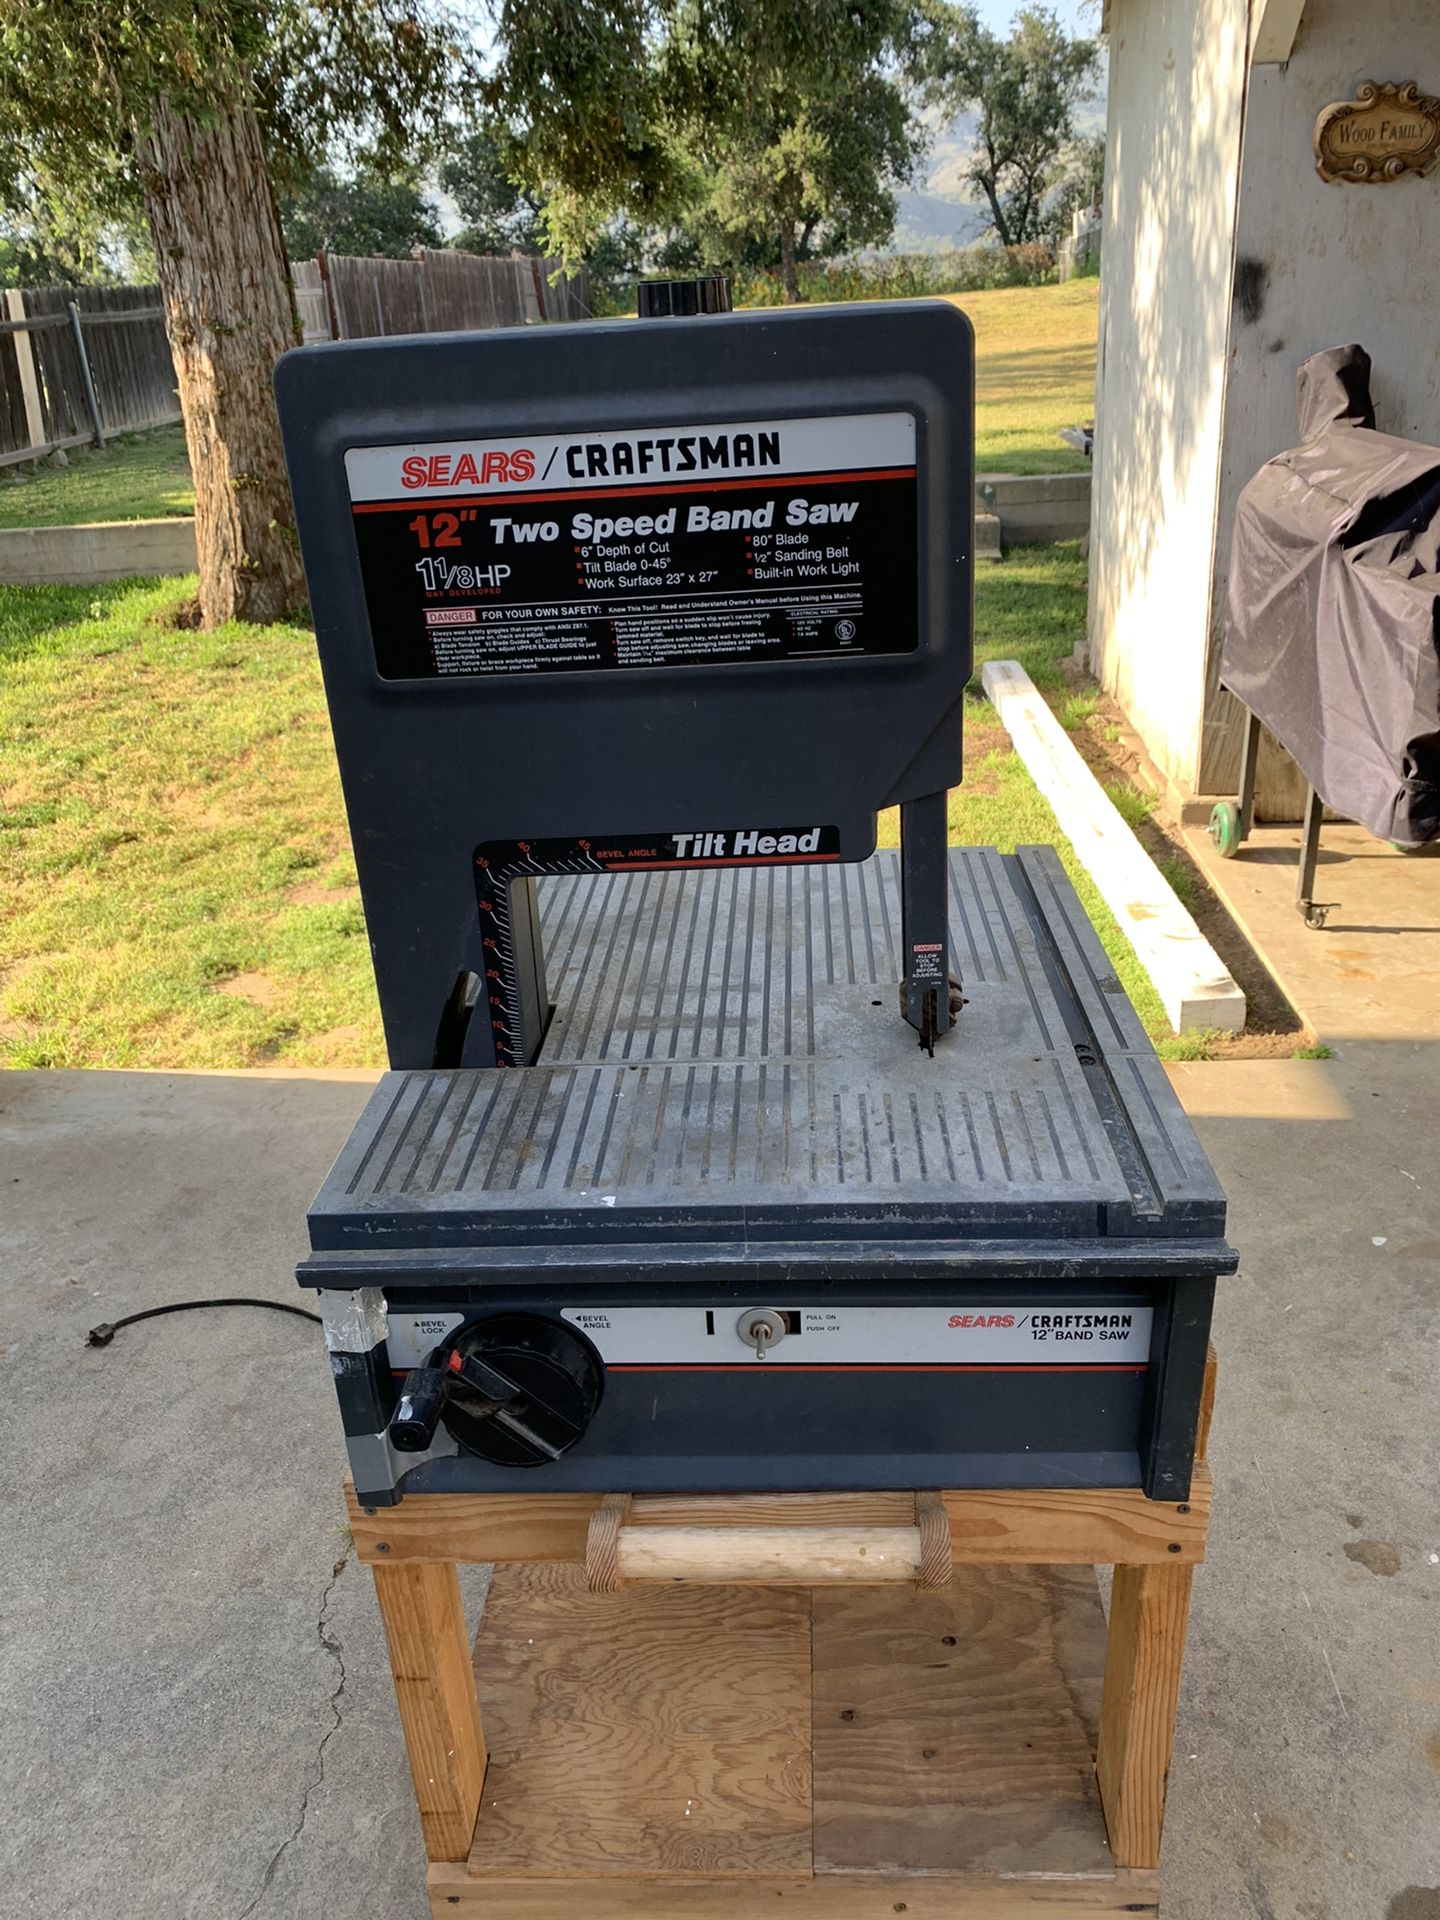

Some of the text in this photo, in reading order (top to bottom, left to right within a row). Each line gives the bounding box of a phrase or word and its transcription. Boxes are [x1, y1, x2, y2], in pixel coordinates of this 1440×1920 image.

[400, 448, 536, 489] SEARS
[565, 431, 780, 478] CRAFTSMAN
[490, 514, 559, 545] Two
[571, 507, 676, 544] Speed
[686, 501, 774, 532] Band
[785, 495, 859, 526] Saw
[775, 532, 808, 545] Blade
[596, 544, 630, 558] Depth
[634, 543, 645, 554] of
[649, 541, 669, 553] Cut
[774, 547, 821, 563] Sanding
[826, 546, 848, 558] Belt
[583, 561, 600, 573] Tilt
[604, 559, 636, 572] Blade
[754, 561, 859, 579] Built-in Work Light
[584, 576, 615, 589] Work
[618, 573, 662, 587] Surface
[449, 587, 501, 596] DEVELOPED
[691, 600, 727, 608] Understand
[801, 594, 819, 602] Using
[429, 611, 473, 622] DANGER
[482, 605, 601, 620] FOR YOUR OWN SAFETY:
[671, 828, 820, 858] Tilt Head
[596, 849, 657, 859] BEVEL ANGLE
[479, 900, 492, 911] 30
[483, 938, 495, 948] 25
[486, 969, 500, 978] 20
[489, 997, 501, 1005] 15
[948, 1315, 1015, 1328] SEARS
[1031, 1315, 1131, 1327] CRAFTSMAN
[1055, 1331, 1093, 1340] BAND
[1099, 1331, 1129, 1340] SAW
